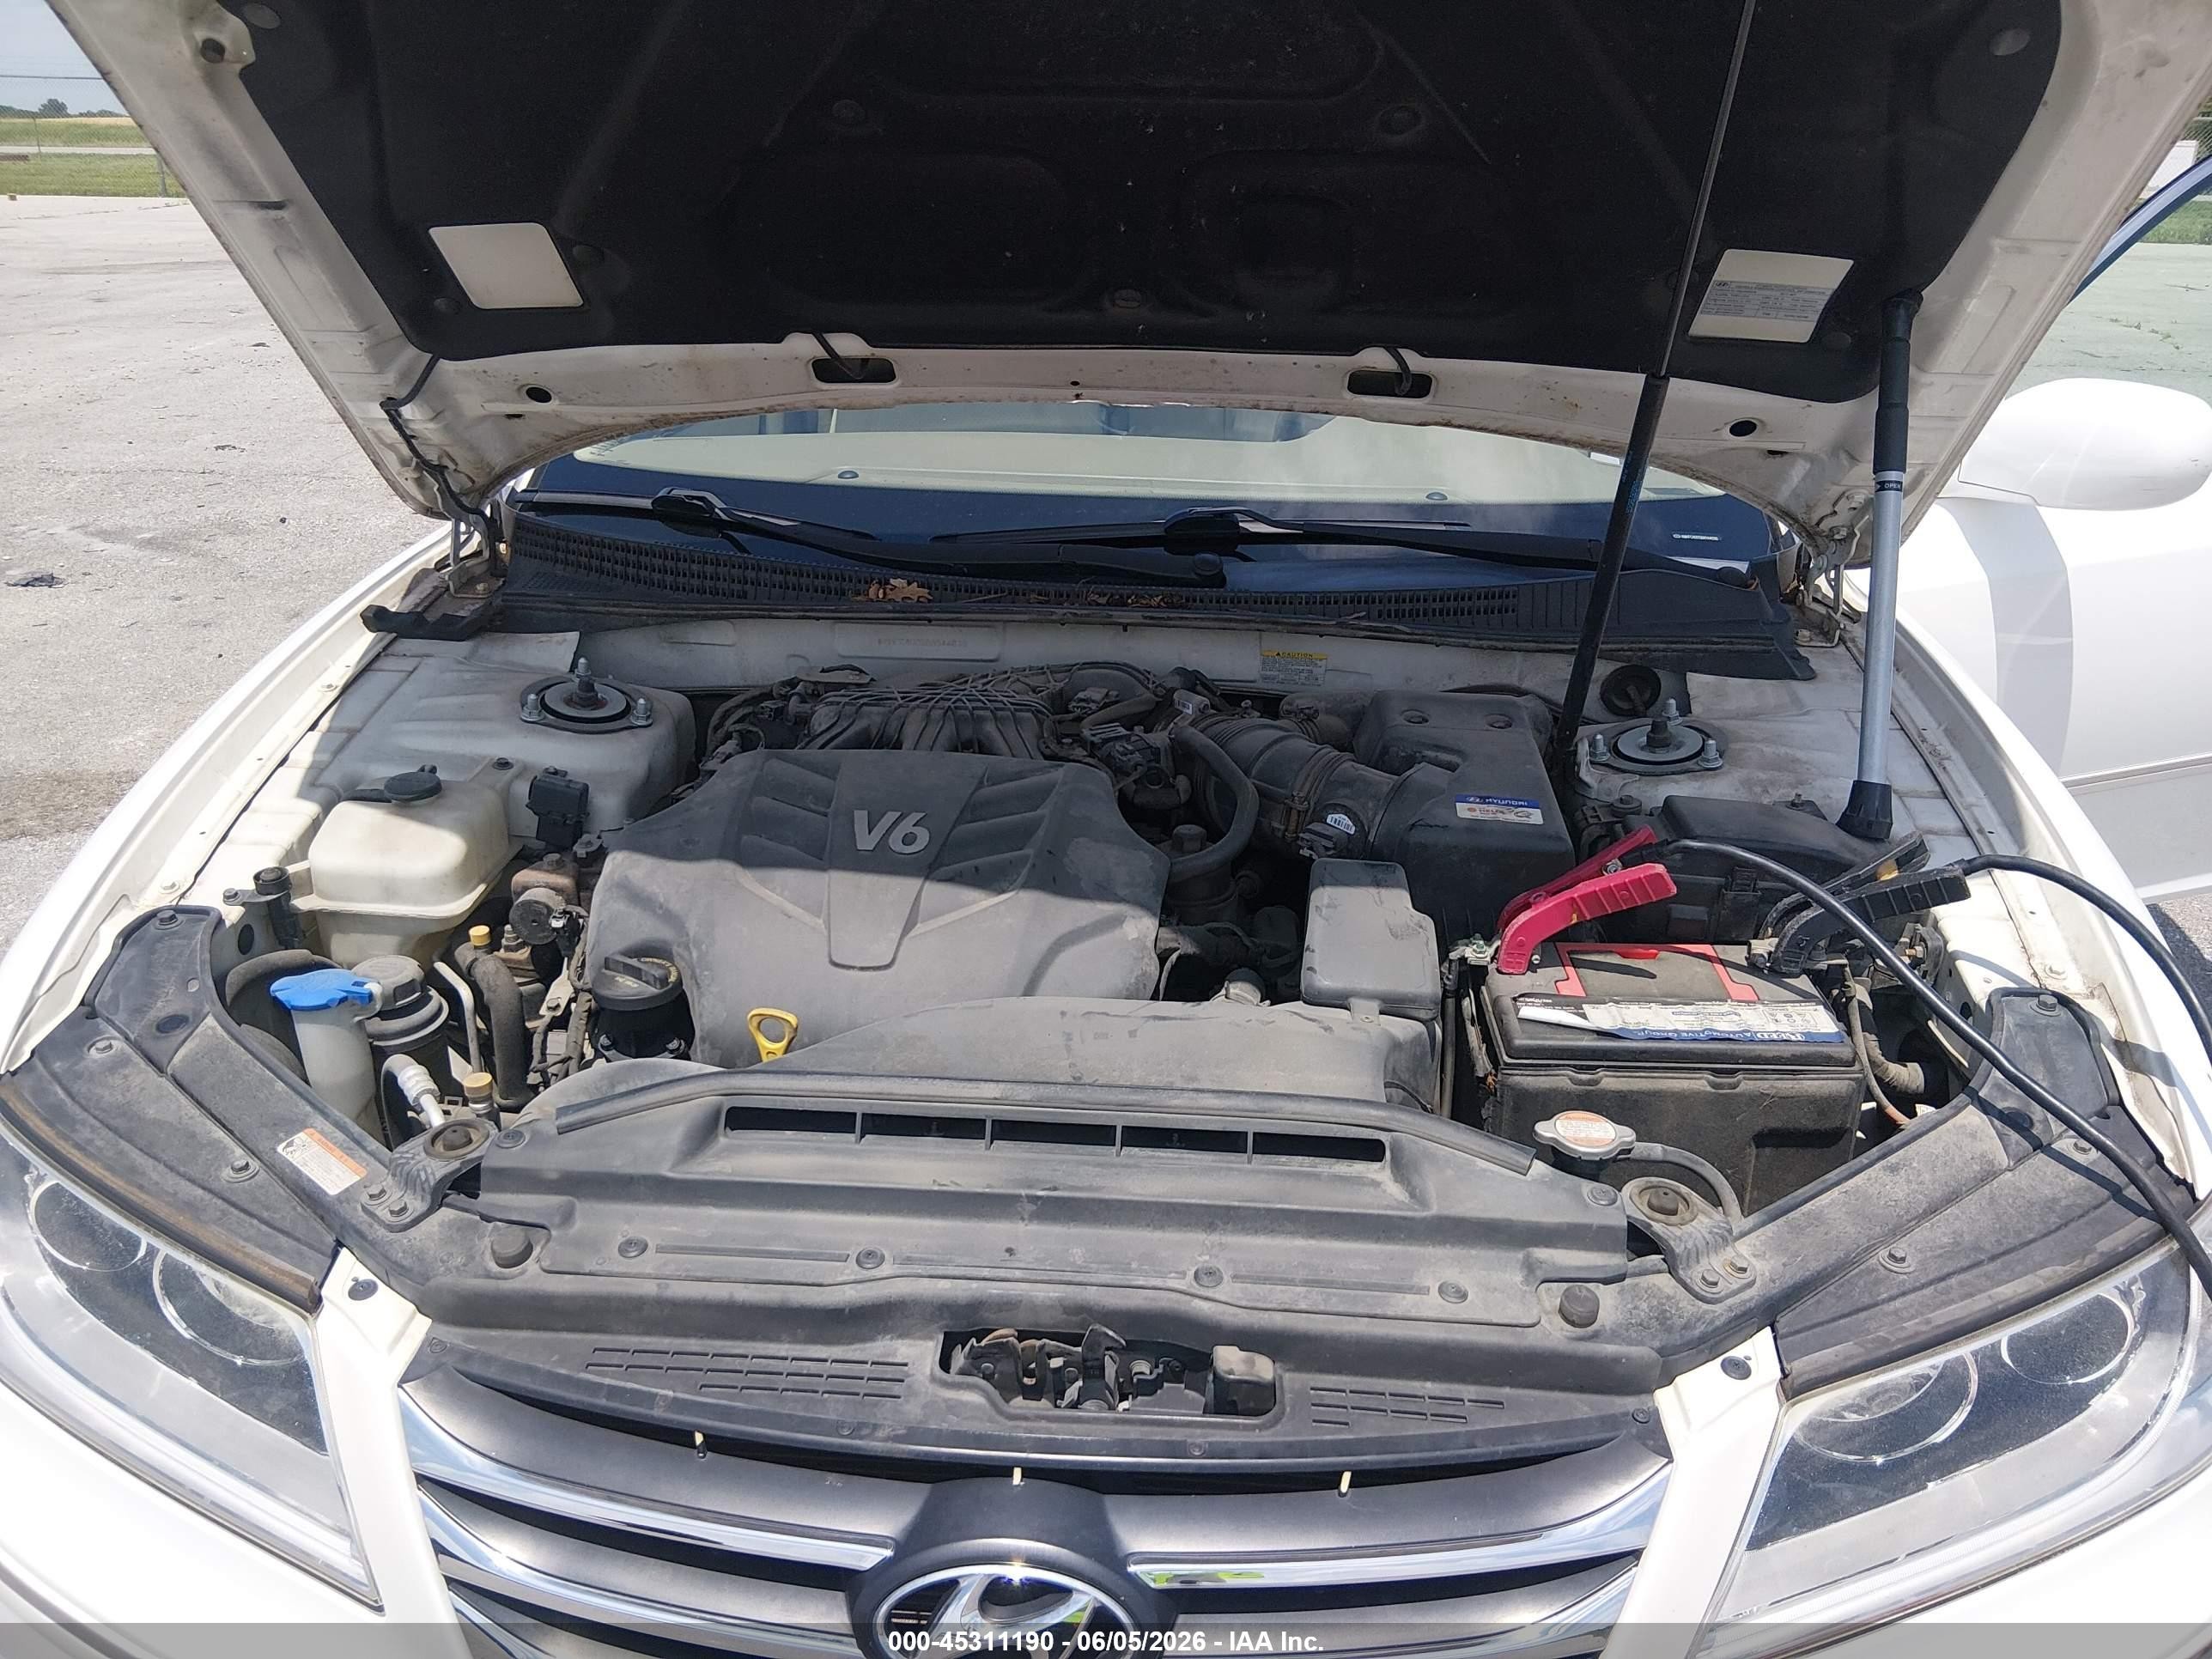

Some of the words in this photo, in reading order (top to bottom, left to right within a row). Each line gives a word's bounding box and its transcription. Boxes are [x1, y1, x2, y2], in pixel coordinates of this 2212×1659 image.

[1486, 798, 1528, 806] HYUNDAI
[854, 810, 931, 855] V6
[1680, 1030, 1752, 1040] AUTOMOTIVE
[1757, 1031, 1804, 1041] REED
